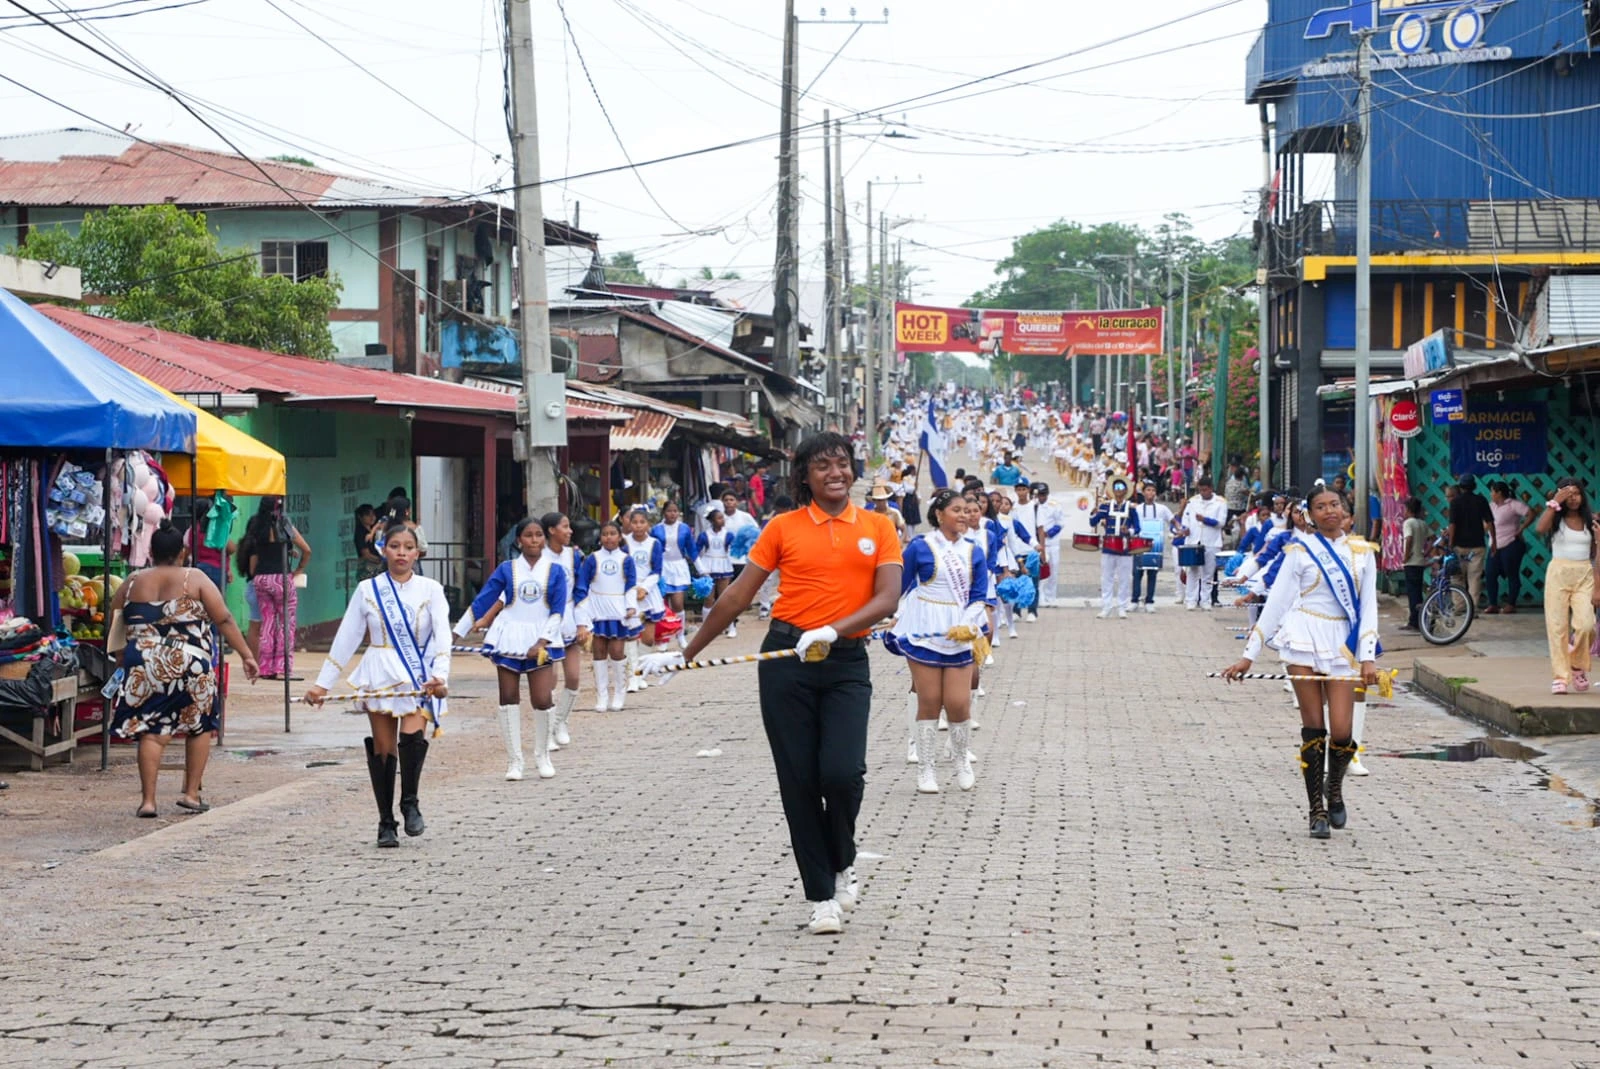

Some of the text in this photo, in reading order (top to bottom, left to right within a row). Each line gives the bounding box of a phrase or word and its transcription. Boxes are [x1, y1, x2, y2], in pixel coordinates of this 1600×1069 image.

[902, 314, 943, 330] HOT
[1112, 317, 1158, 329] curacao
[1018, 323, 1061, 334] QUIEREN
[902, 330, 942, 342] WEEK
[1392, 410, 1416, 421] Claro
[1463, 411, 1536, 424] ARMACIA
[1475, 428, 1521, 441] JOSUE
